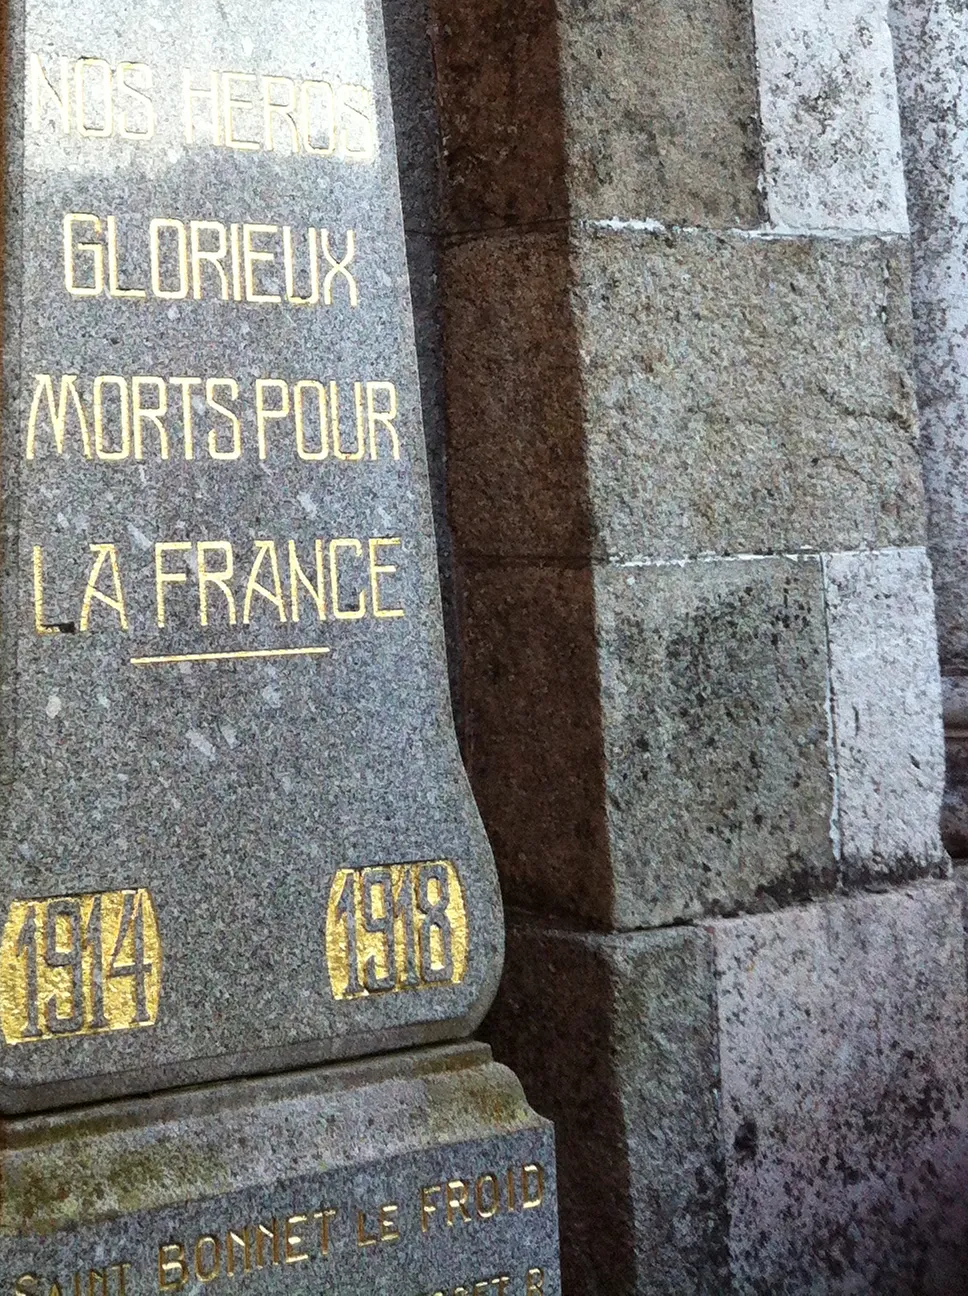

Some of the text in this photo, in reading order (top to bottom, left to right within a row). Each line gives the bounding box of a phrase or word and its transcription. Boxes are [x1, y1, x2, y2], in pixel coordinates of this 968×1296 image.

[31, 52, 380, 161] NOS HEROS
[62, 212, 359, 307] GLORIEUX
[26, 372, 402, 462] MORTS POUR
[32, 536, 406, 635] LA FRANCE
[16, 863, 456, 1040] 1914 1918
[158, 1209, 337, 1292] BONNET
[357, 1204, 400, 1247] LE
[420, 1163, 545, 1233] FROID
